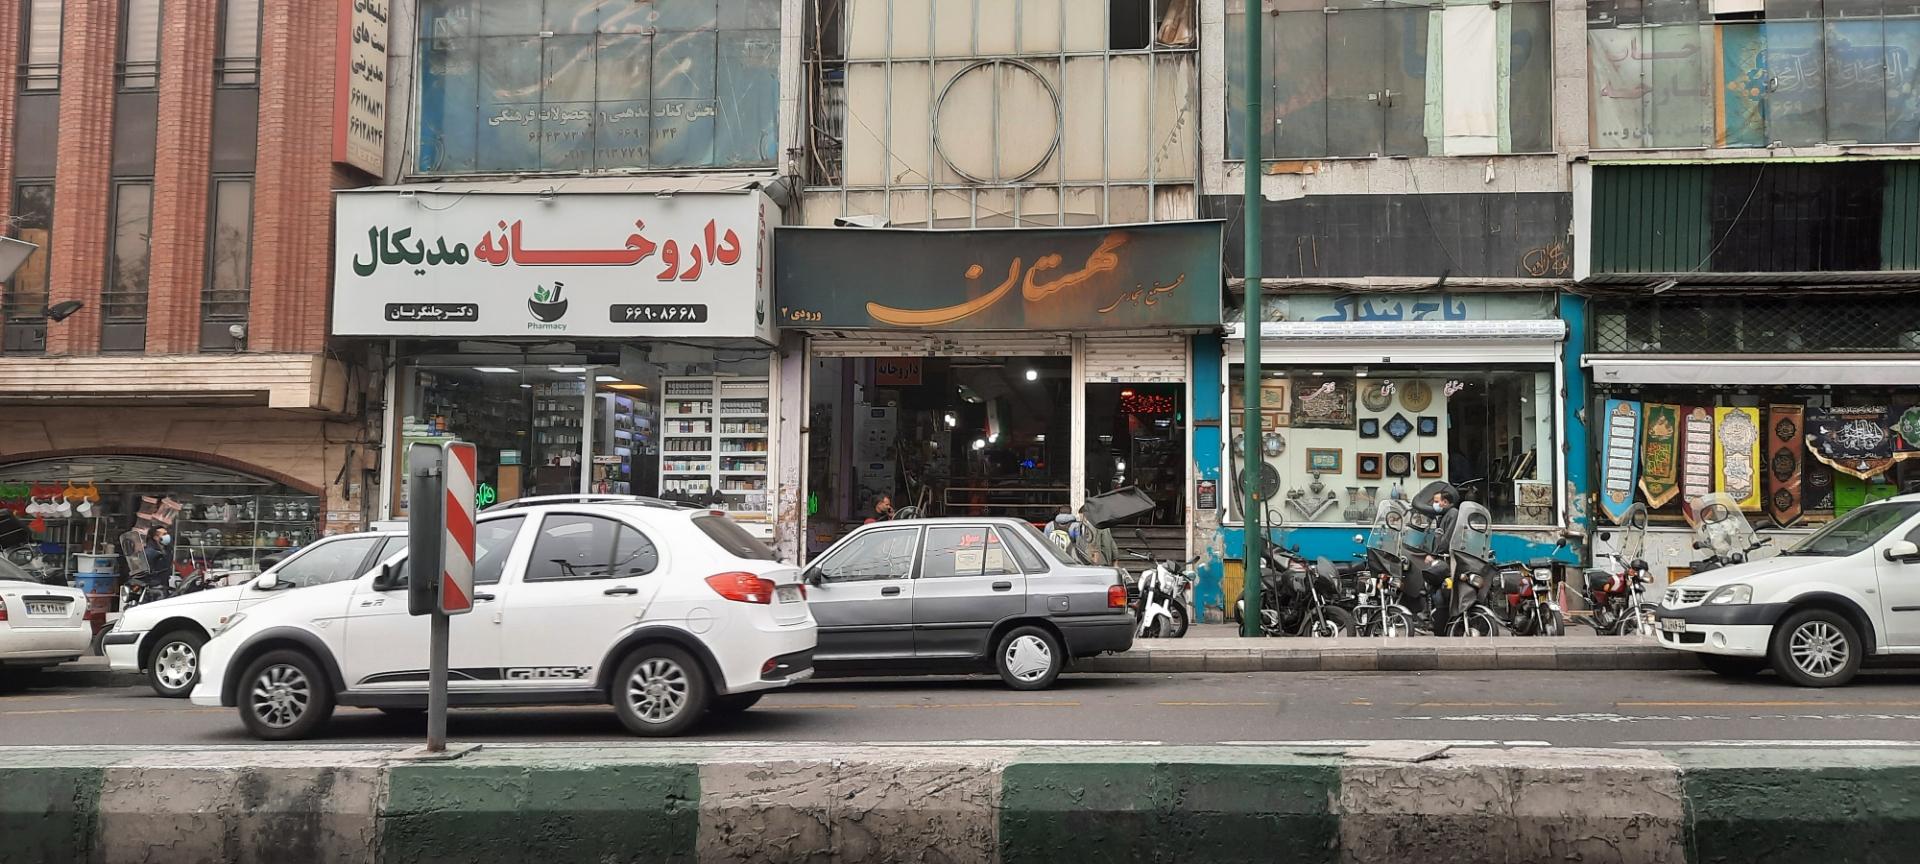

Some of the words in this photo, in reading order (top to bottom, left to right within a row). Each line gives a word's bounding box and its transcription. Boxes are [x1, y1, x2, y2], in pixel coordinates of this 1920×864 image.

[353, 21, 370, 44] های
[352, 54, 384, 82] مدیریتی
[686, 105, 717, 123] خش
[352, 225, 470, 277] مدیکال
[473, 218, 741, 282] داروخانه
[624, 306, 697, 321] ۶۶۹۰۸۶۶۸
[790, 309, 822, 321] ورودی
[527, 321, 568, 332] Pharmacy
[505, 667, 577, 680] CROSS
